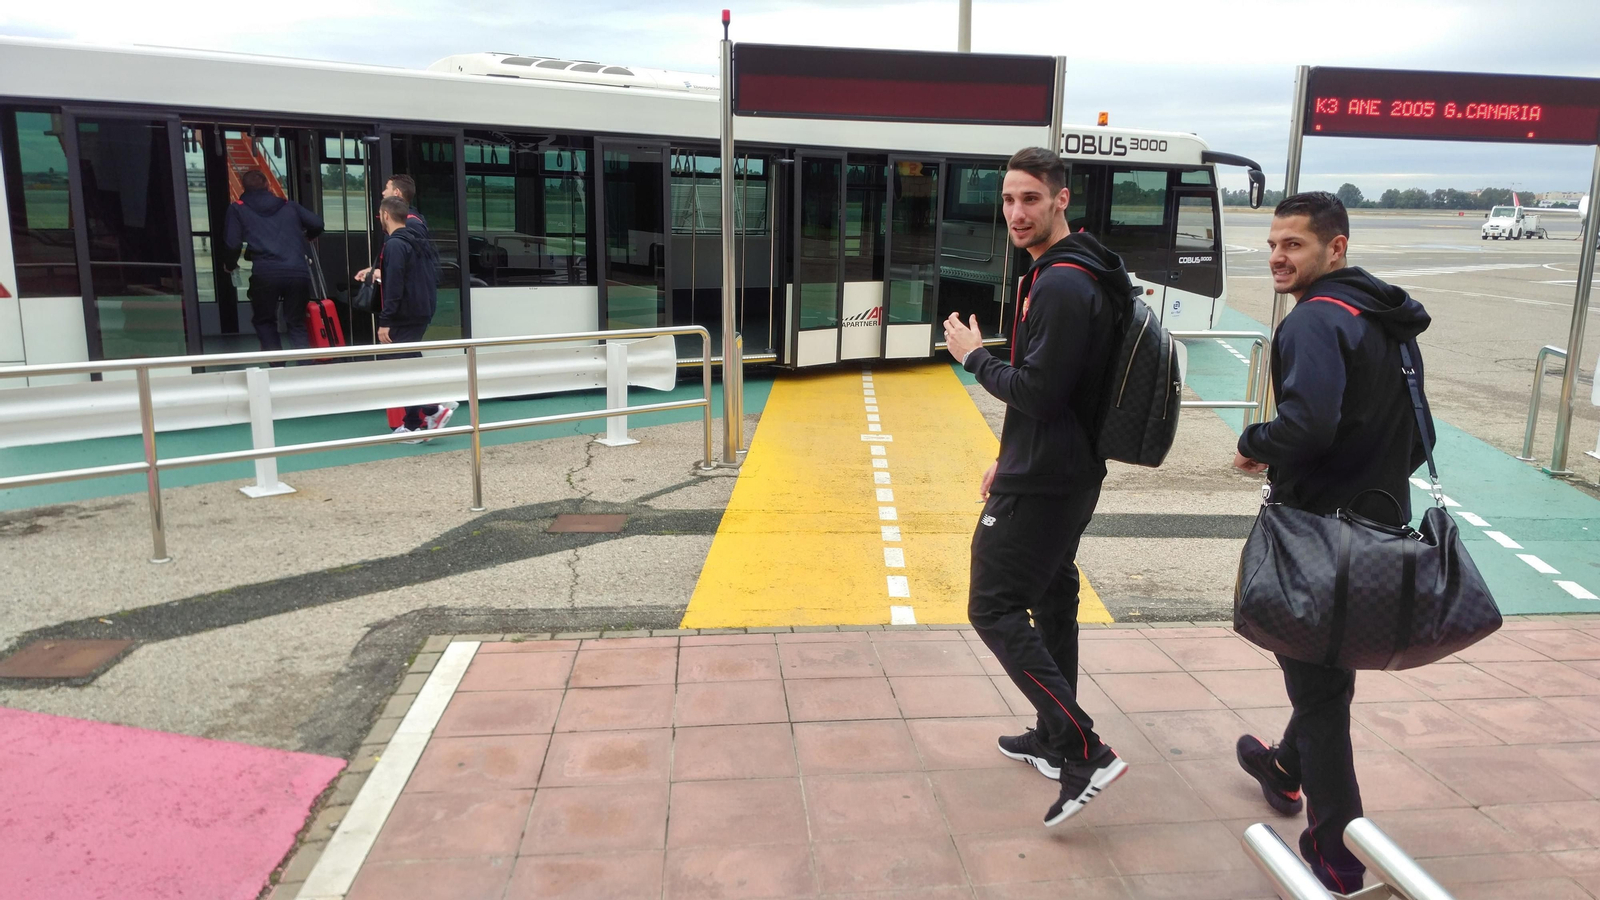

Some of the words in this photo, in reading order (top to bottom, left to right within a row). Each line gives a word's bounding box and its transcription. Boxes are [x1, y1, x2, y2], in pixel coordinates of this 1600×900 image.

[1316, 98, 1338, 114] K3
[1349, 99, 1381, 115] ANE
[1391, 101, 1435, 118] 2005
[1444, 103, 1541, 121] G.CANARIA
[1061, 133, 1127, 156] OBUS
[1130, 138, 1167, 152] 3000
